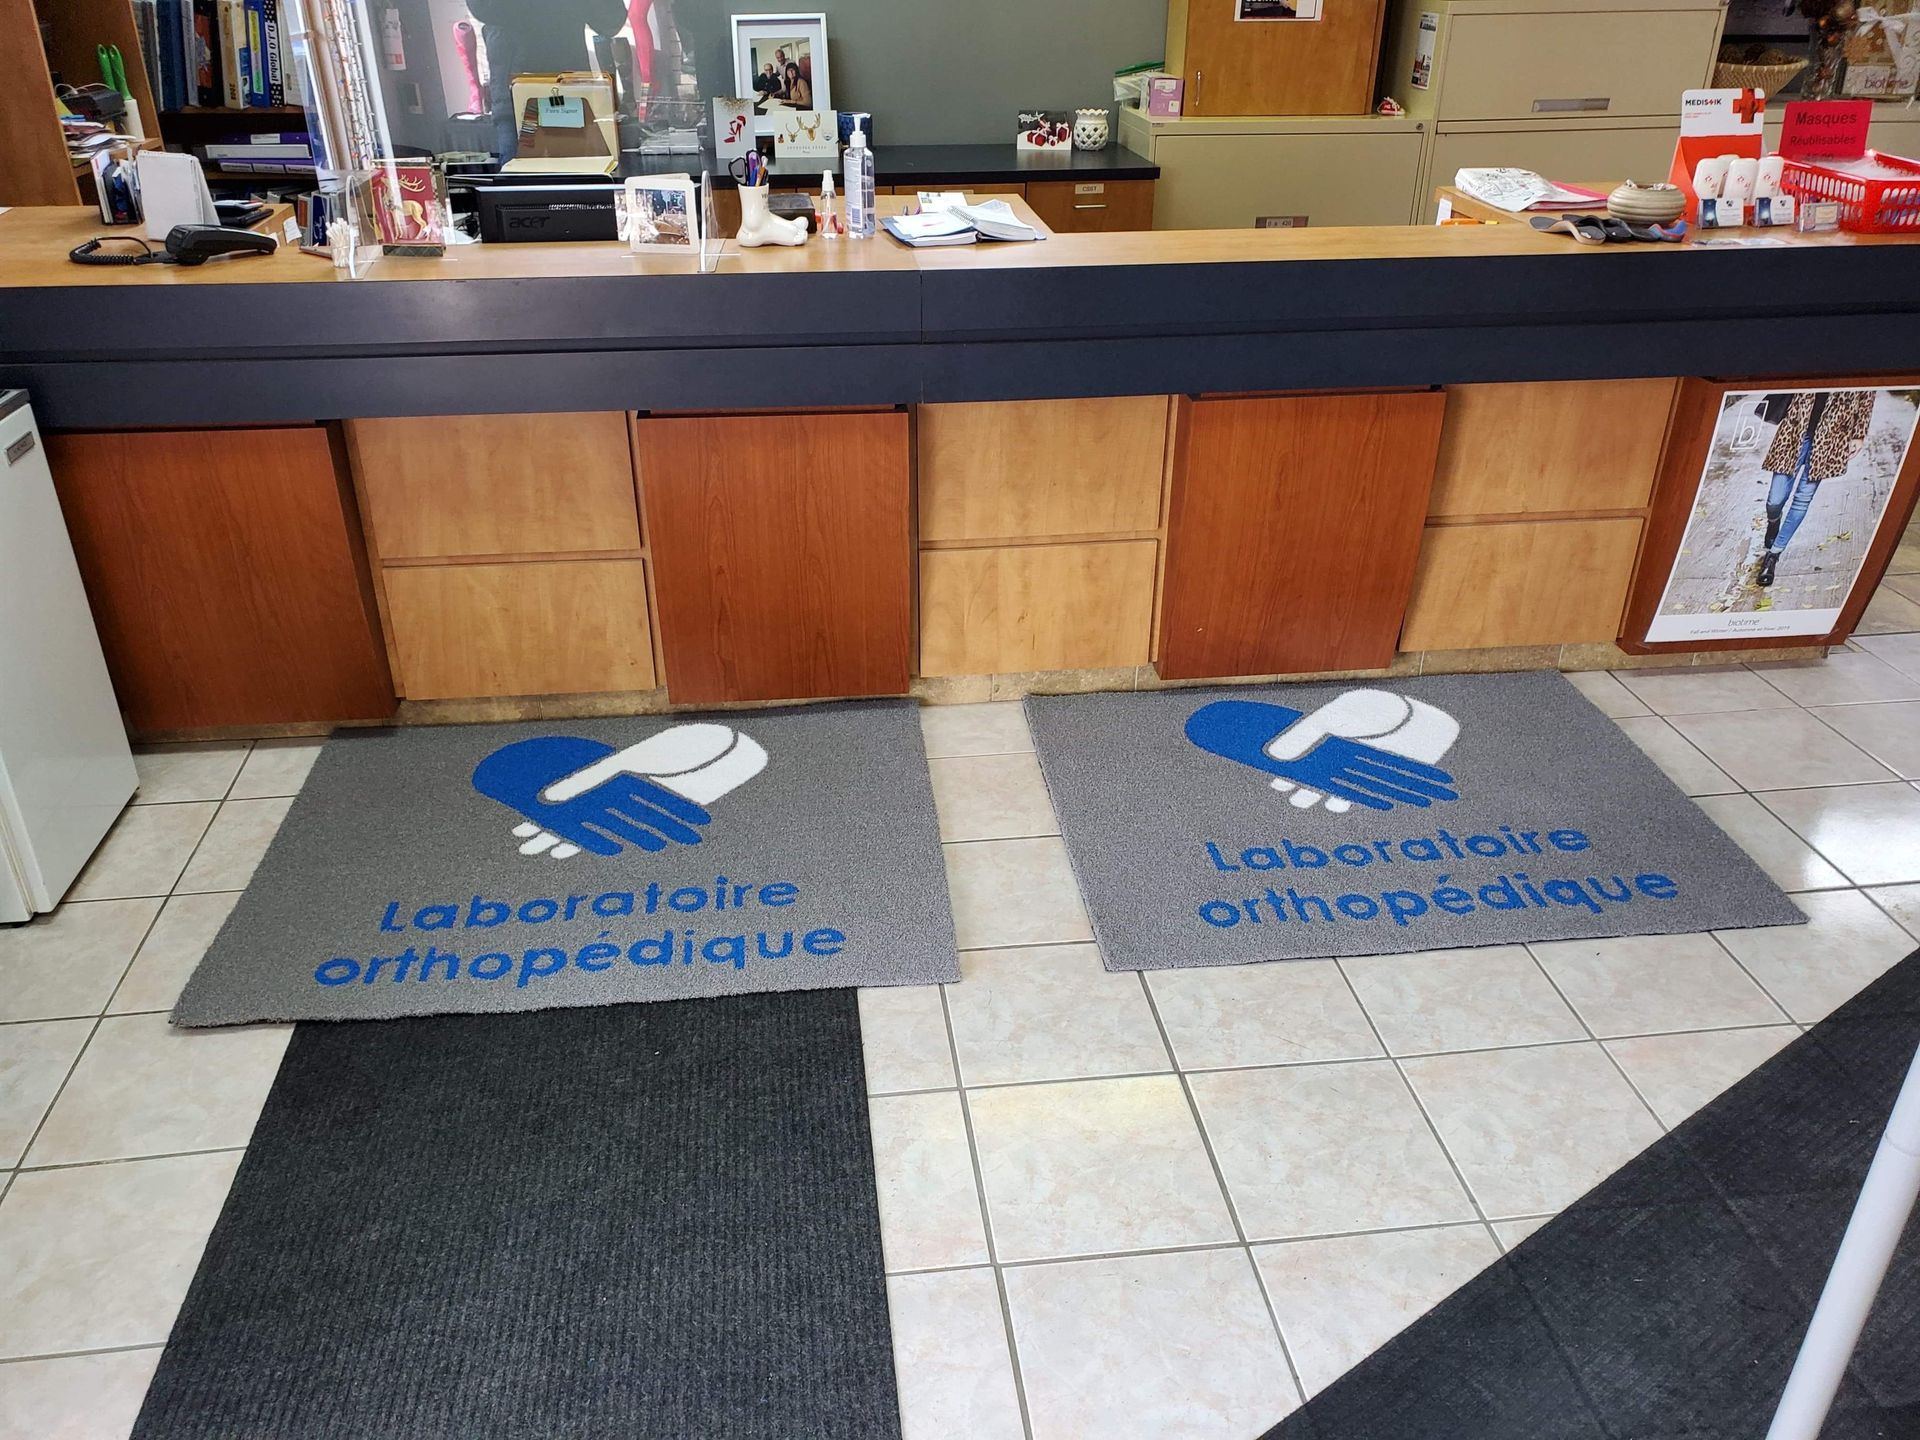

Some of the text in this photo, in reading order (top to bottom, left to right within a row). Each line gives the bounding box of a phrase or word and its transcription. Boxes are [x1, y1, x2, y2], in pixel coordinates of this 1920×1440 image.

[269, 52, 279, 82] Global
[1795, 112, 1857, 128] Masques
[509, 215, 551, 229] acer
[1206, 825, 1592, 873] Laboratoire
[379, 875, 800, 932] Laboratoire
[1200, 872, 1679, 928] orthopédique
[314, 928, 847, 989] orthopédique
